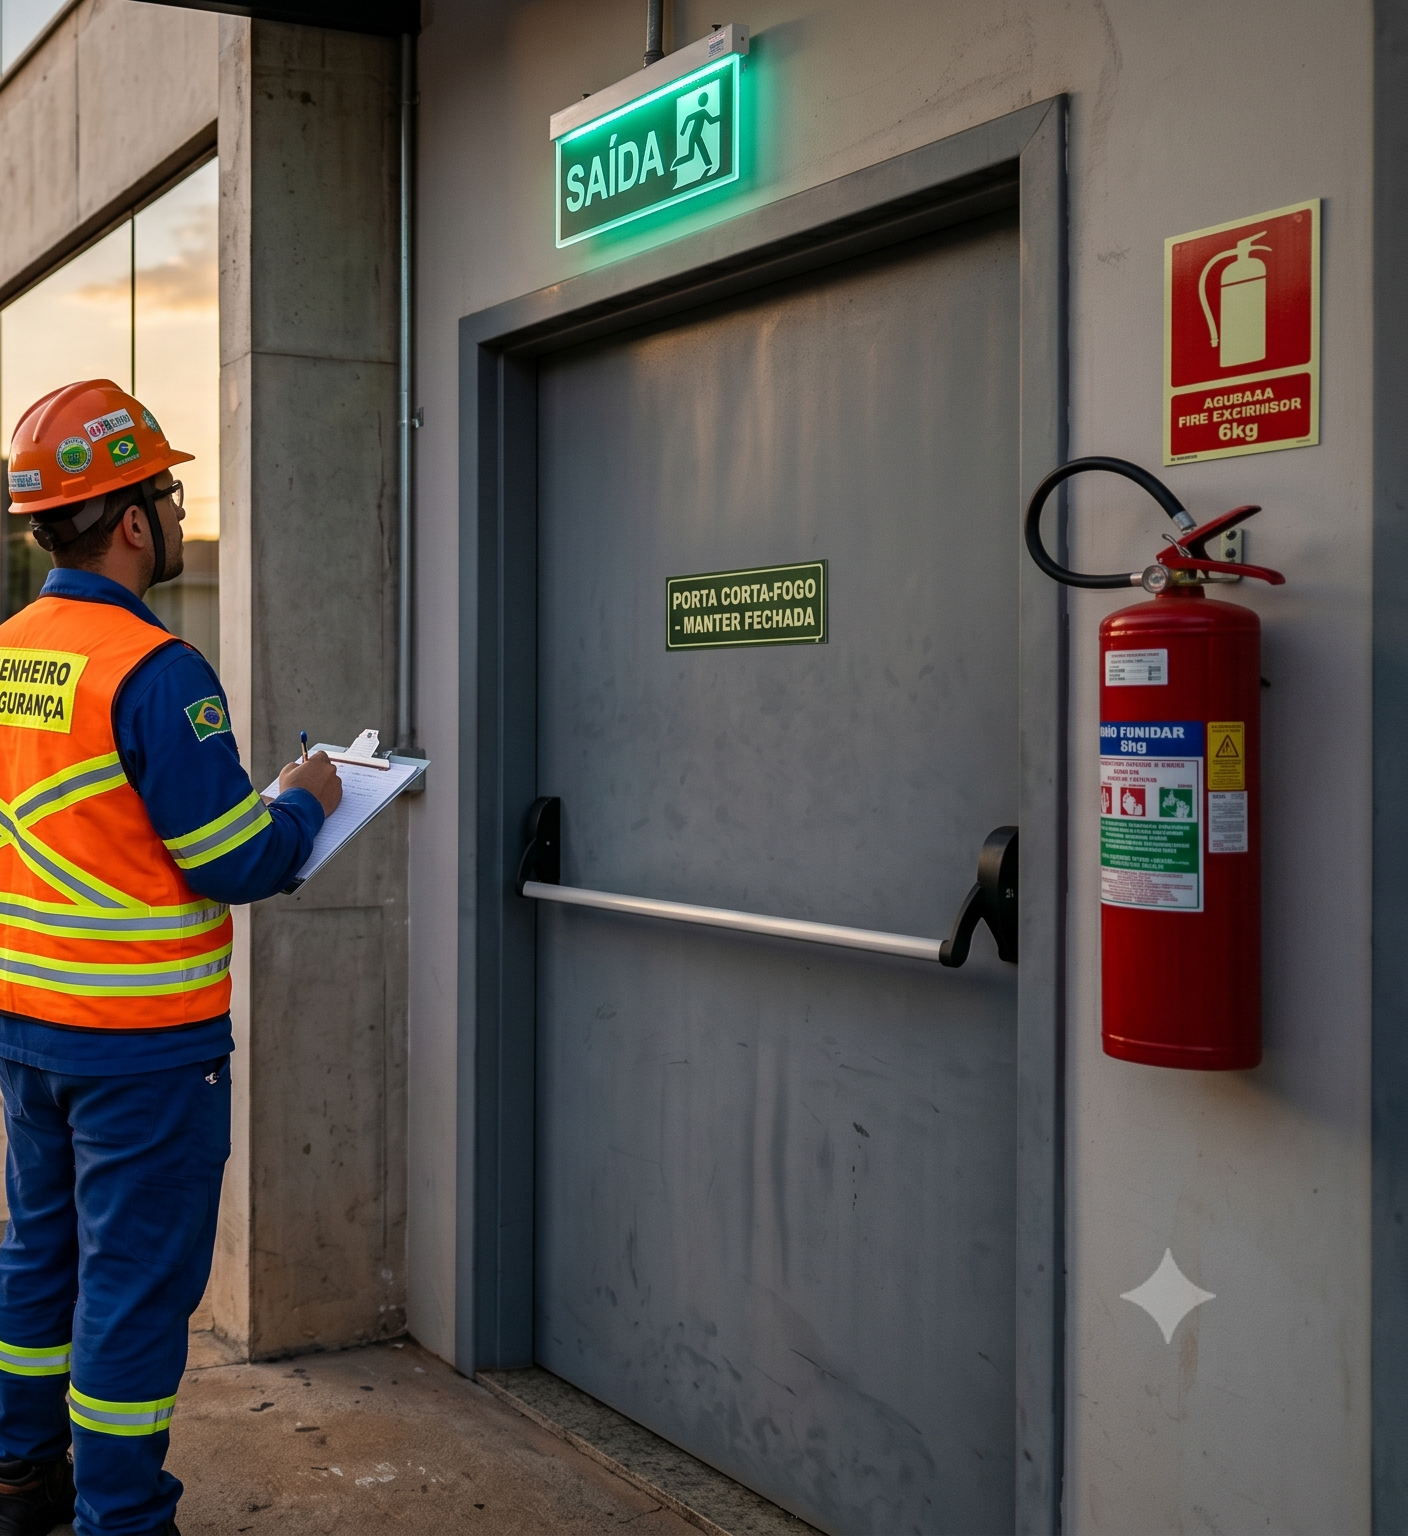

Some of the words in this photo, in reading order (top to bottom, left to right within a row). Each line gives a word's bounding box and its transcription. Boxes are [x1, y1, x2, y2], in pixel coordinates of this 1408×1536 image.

[566, 131, 664, 212] SAÍDA
[1178, 412, 1209, 428] FIRE
[1218, 422, 1258, 441] 6kg
[673, 589, 718, 610] PORTA
[721, 578, 816, 606] CORTA-FOGO
[683, 612, 741, 634] MANTER
[744, 606, 815, 630] FECHADA
